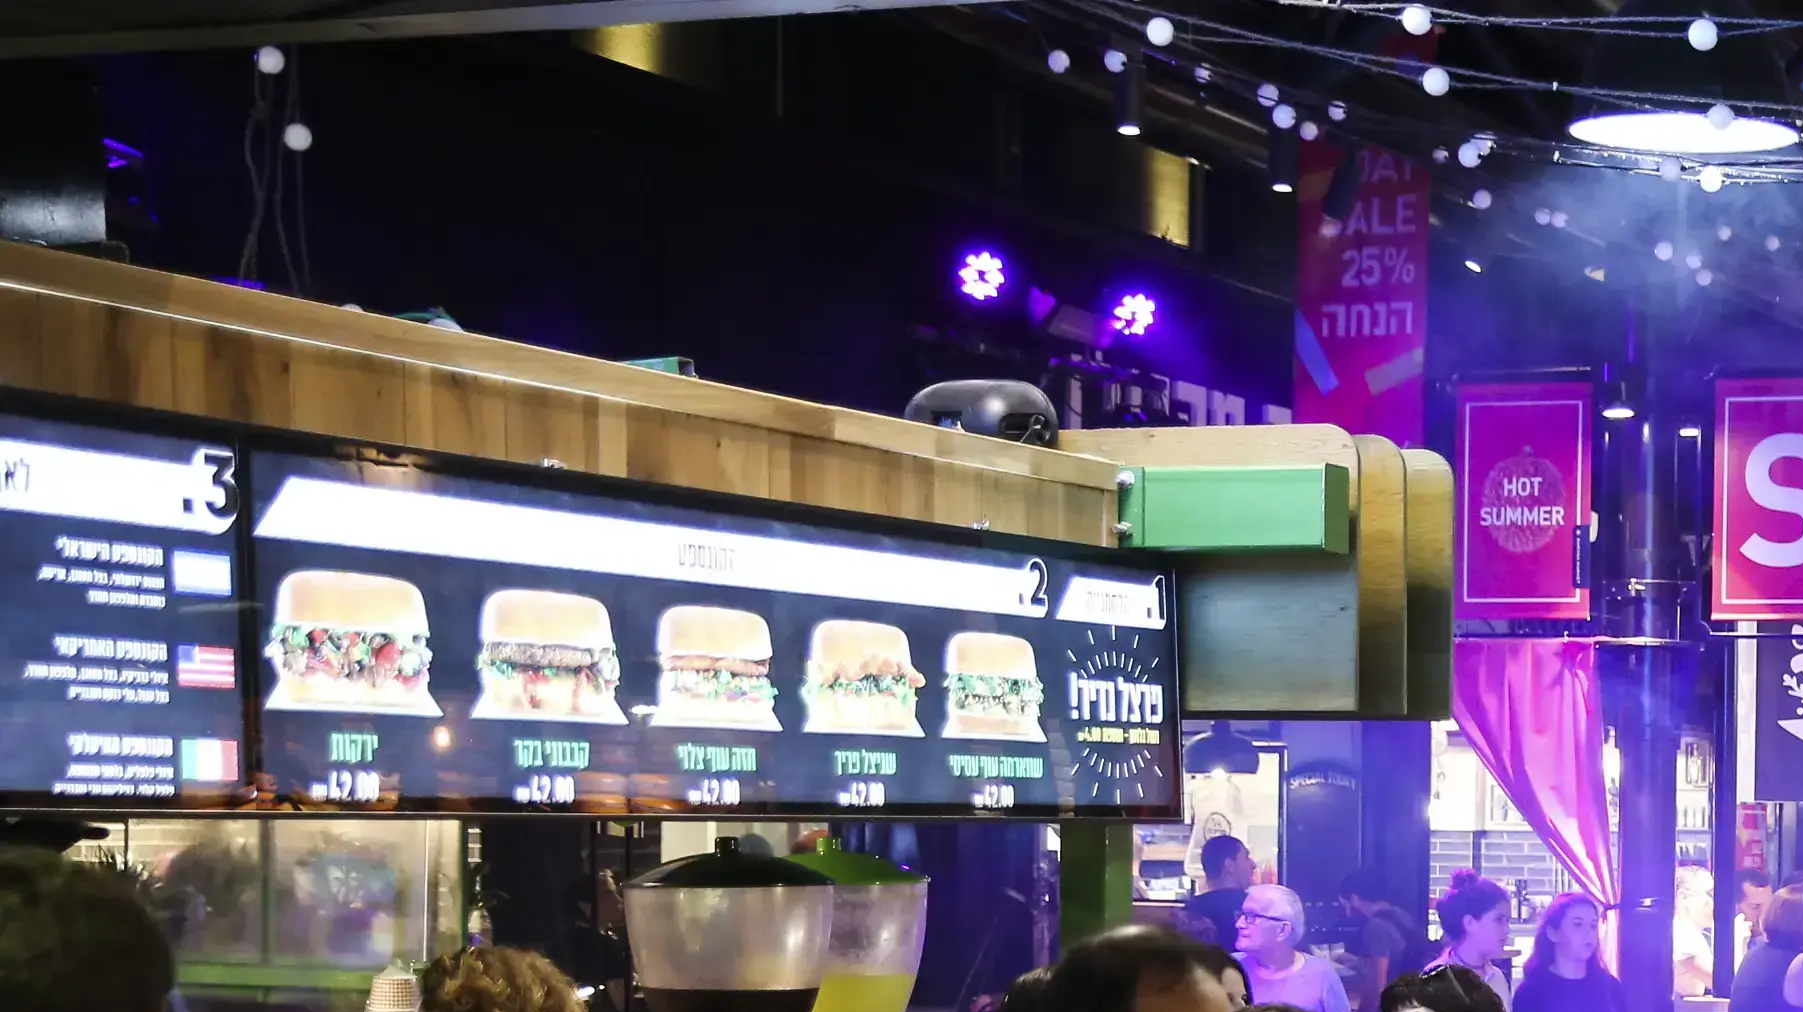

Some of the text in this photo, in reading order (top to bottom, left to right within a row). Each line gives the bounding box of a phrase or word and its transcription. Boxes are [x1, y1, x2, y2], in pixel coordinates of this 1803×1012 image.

[1345, 194, 1416, 235] ALE
[1341, 247, 1415, 287] 25%
[1321, 301, 1413, 338] הנחה
[1503, 476, 1543, 496] HOT
[1480, 505, 1565, 526] SUMMER
[1117, 676, 1164, 724] פרצל
[331, 734, 379, 764] ירקות
[514, 740, 590, 769] קבבוני בקר
[678, 743, 757, 773] חזה עוף צלוי
[834, 748, 897, 775] שניצל פריך
[980, 755, 999, 779] עוף
